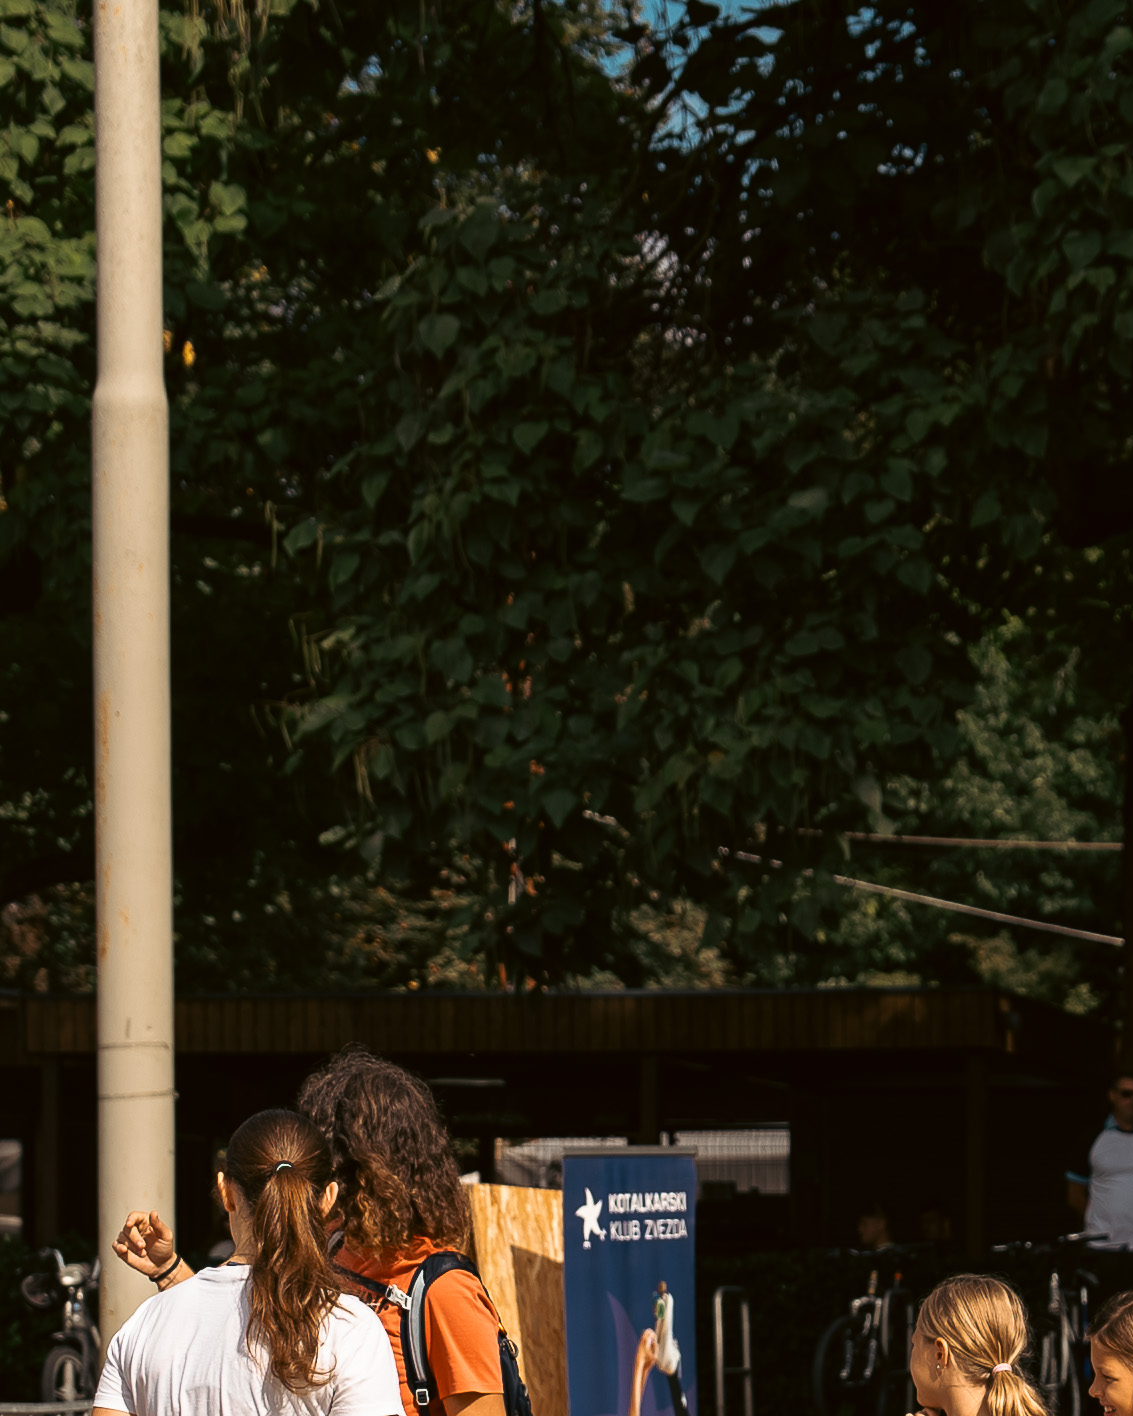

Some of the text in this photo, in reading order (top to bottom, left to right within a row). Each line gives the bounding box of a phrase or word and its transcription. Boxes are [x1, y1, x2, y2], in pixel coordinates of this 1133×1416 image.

[608, 1191, 687, 1214] KOTALKARSKI
[609, 1218, 688, 1241] KLUB ZVEZDA
